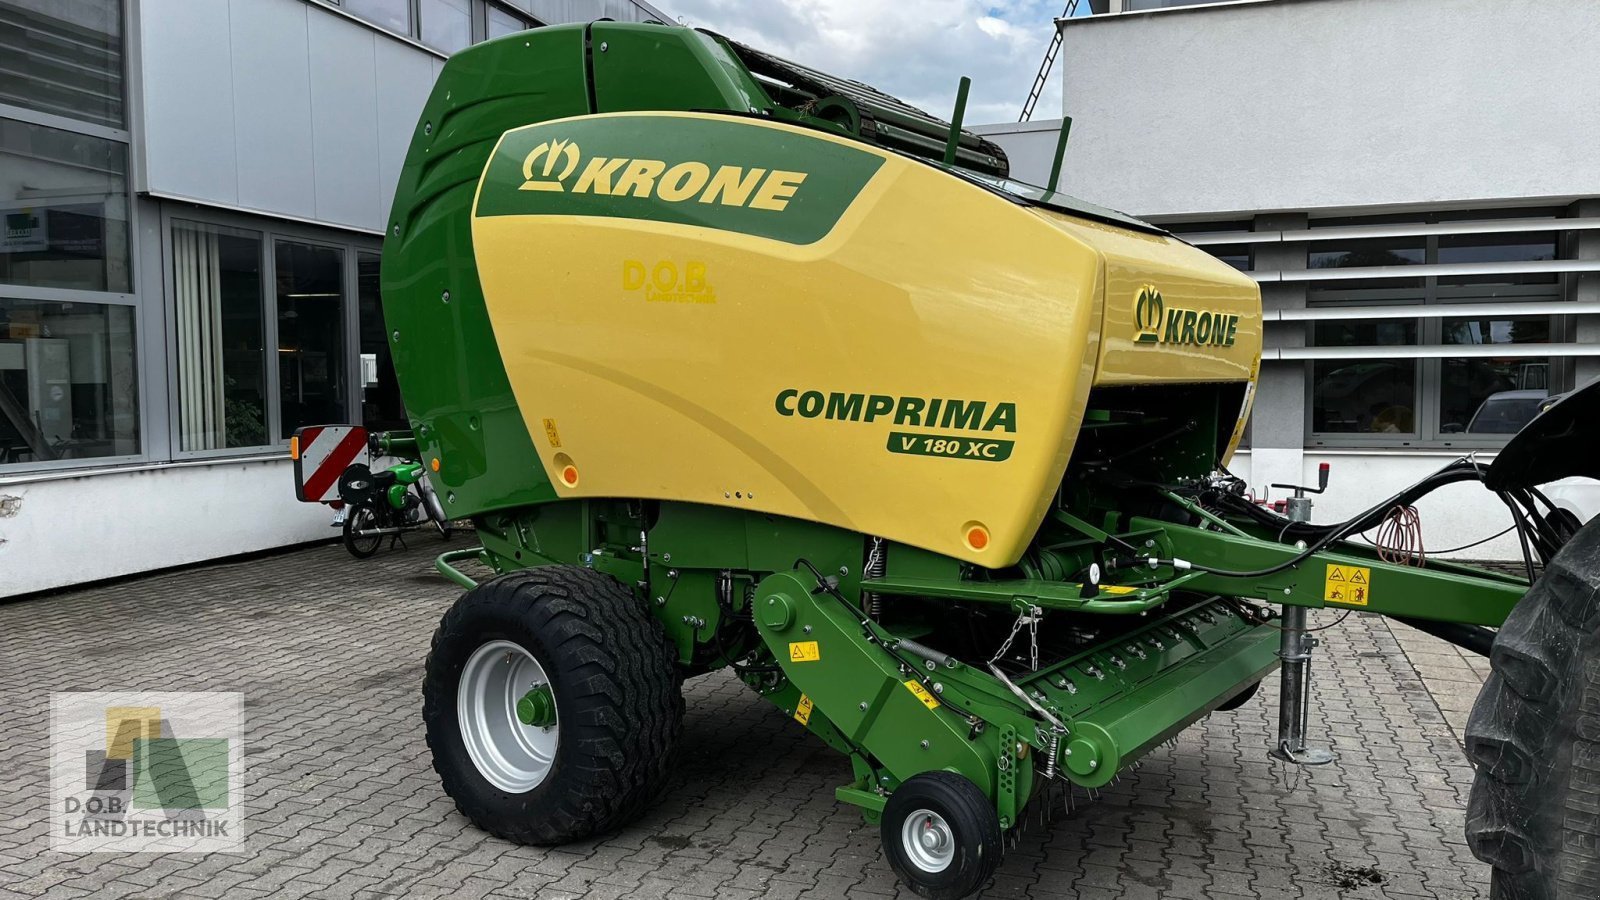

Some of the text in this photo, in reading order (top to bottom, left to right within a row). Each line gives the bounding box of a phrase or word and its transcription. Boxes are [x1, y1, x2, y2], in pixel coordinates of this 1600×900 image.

[571, 157, 808, 211] KRONE
[623, 260, 713, 293] D.O.B.
[1162, 308, 1239, 346] KRONE
[775, 389, 1017, 433] COMPRIMA
[901, 436, 1000, 458] V 180 XC
